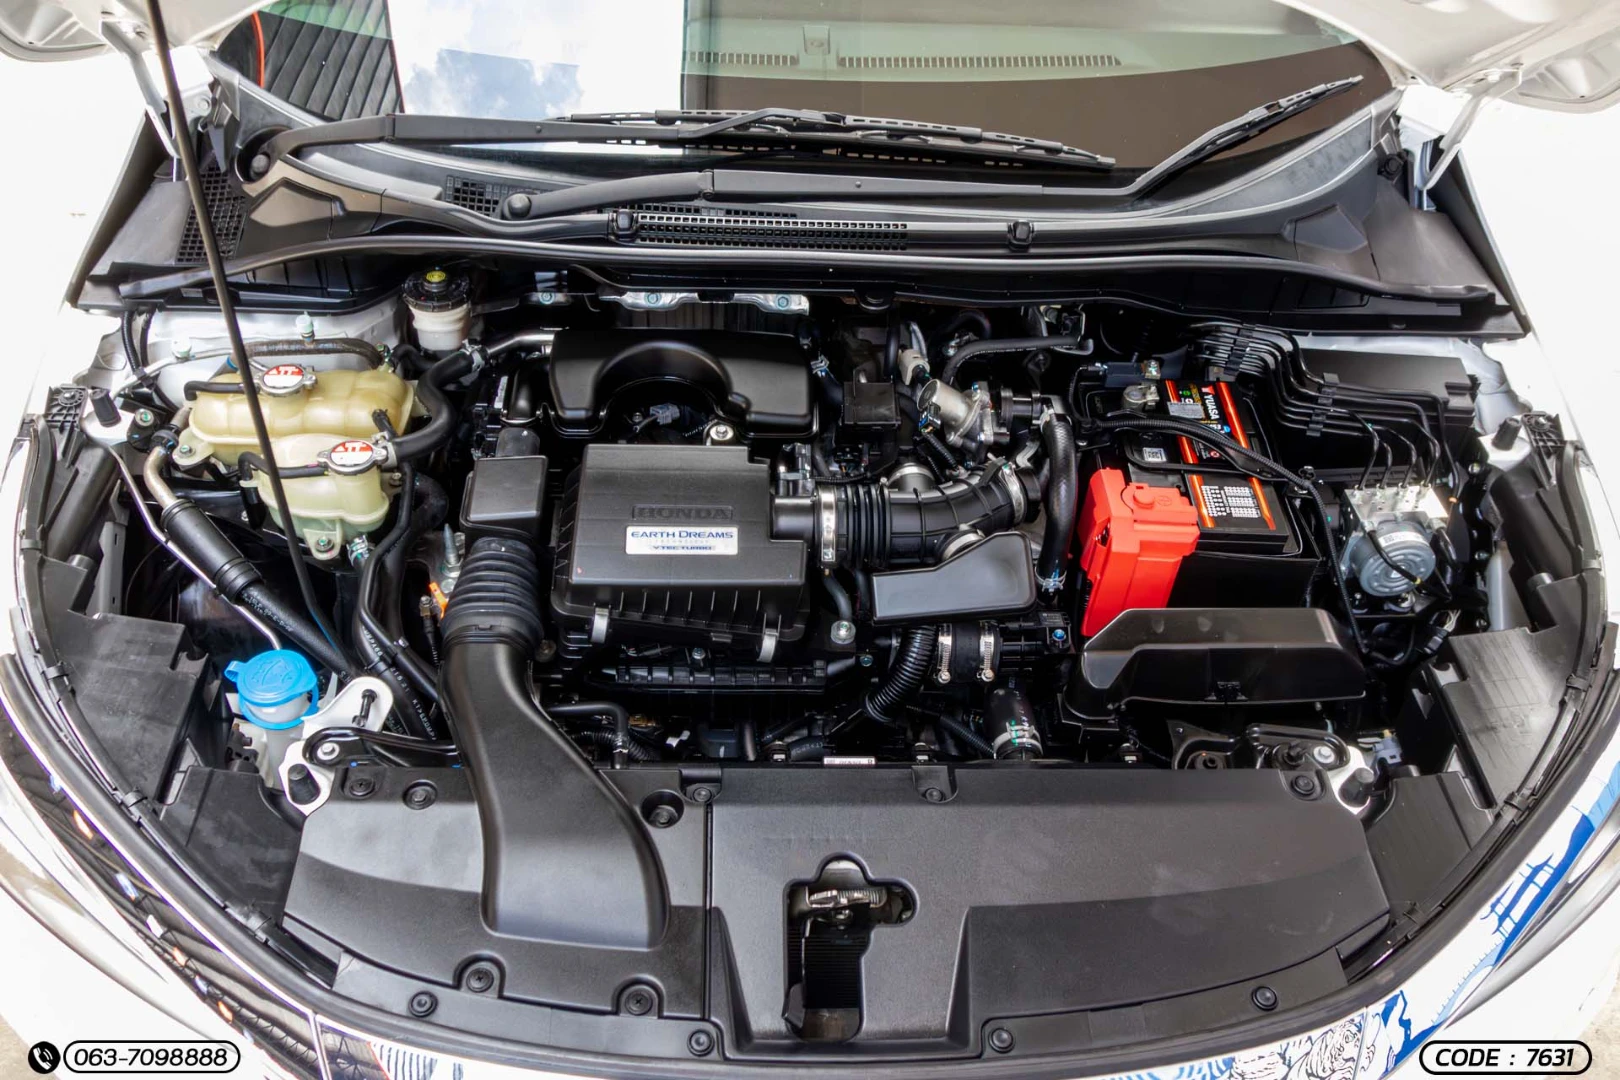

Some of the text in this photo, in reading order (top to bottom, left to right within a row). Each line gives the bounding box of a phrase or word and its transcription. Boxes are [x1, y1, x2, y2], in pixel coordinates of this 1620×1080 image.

[1203, 394, 1220, 420] YUASA
[637, 507, 730, 520] HONDA
[630, 529, 734, 539] EARTH DREAMS
